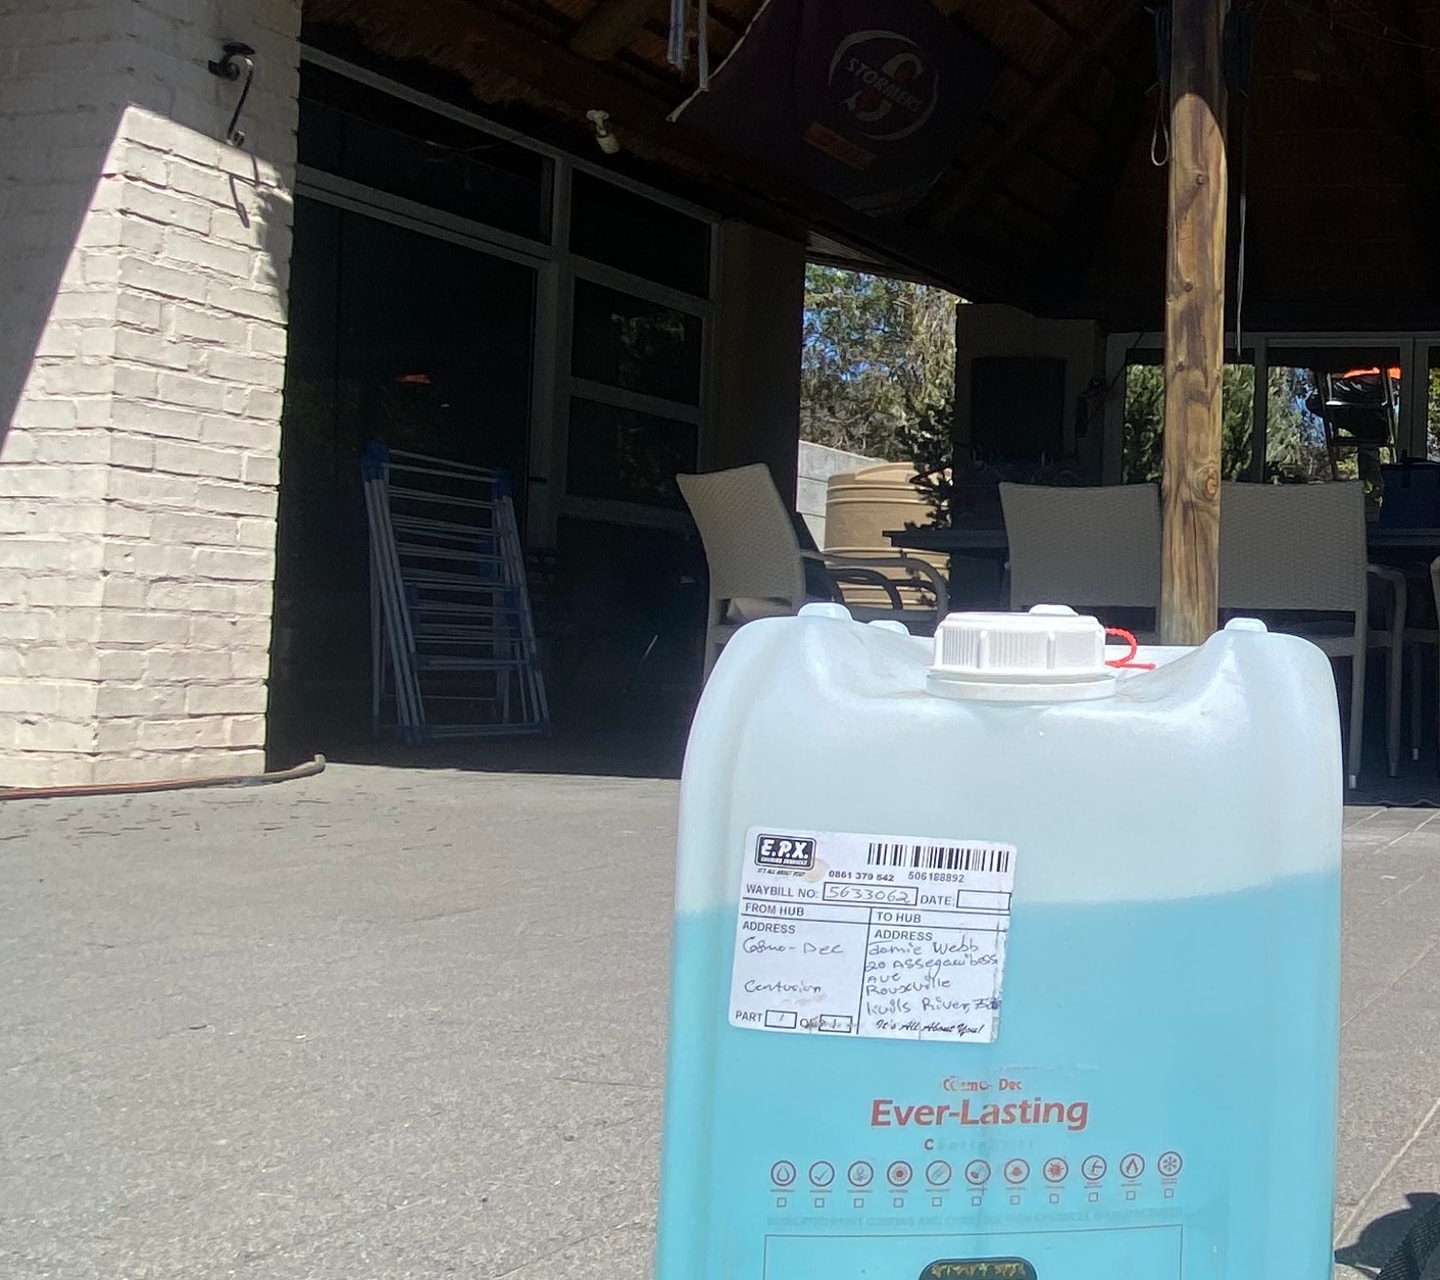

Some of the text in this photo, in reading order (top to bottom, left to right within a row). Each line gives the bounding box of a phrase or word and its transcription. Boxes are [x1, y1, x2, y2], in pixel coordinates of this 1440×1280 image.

[844, 58, 924, 112] STORMERS
[760, 838, 809, 860] E.P.X.
[828, 870, 852, 879] 0861
[855, 871, 874, 881] 379
[746, 883, 794, 898] WAYBILL
[920, 895, 955, 907] DATE:
[745, 902, 805, 917] FROM HUB
[876, 911, 921, 924] TO HUB
[742, 921, 796, 935] ADDRESS
[874, 929, 933, 941] ADDRESS
[735, 1010, 763, 1023] PART
[998, 1078, 1022, 1092] Dec
[870, 1096, 1089, 1132] Ever-Lasting
